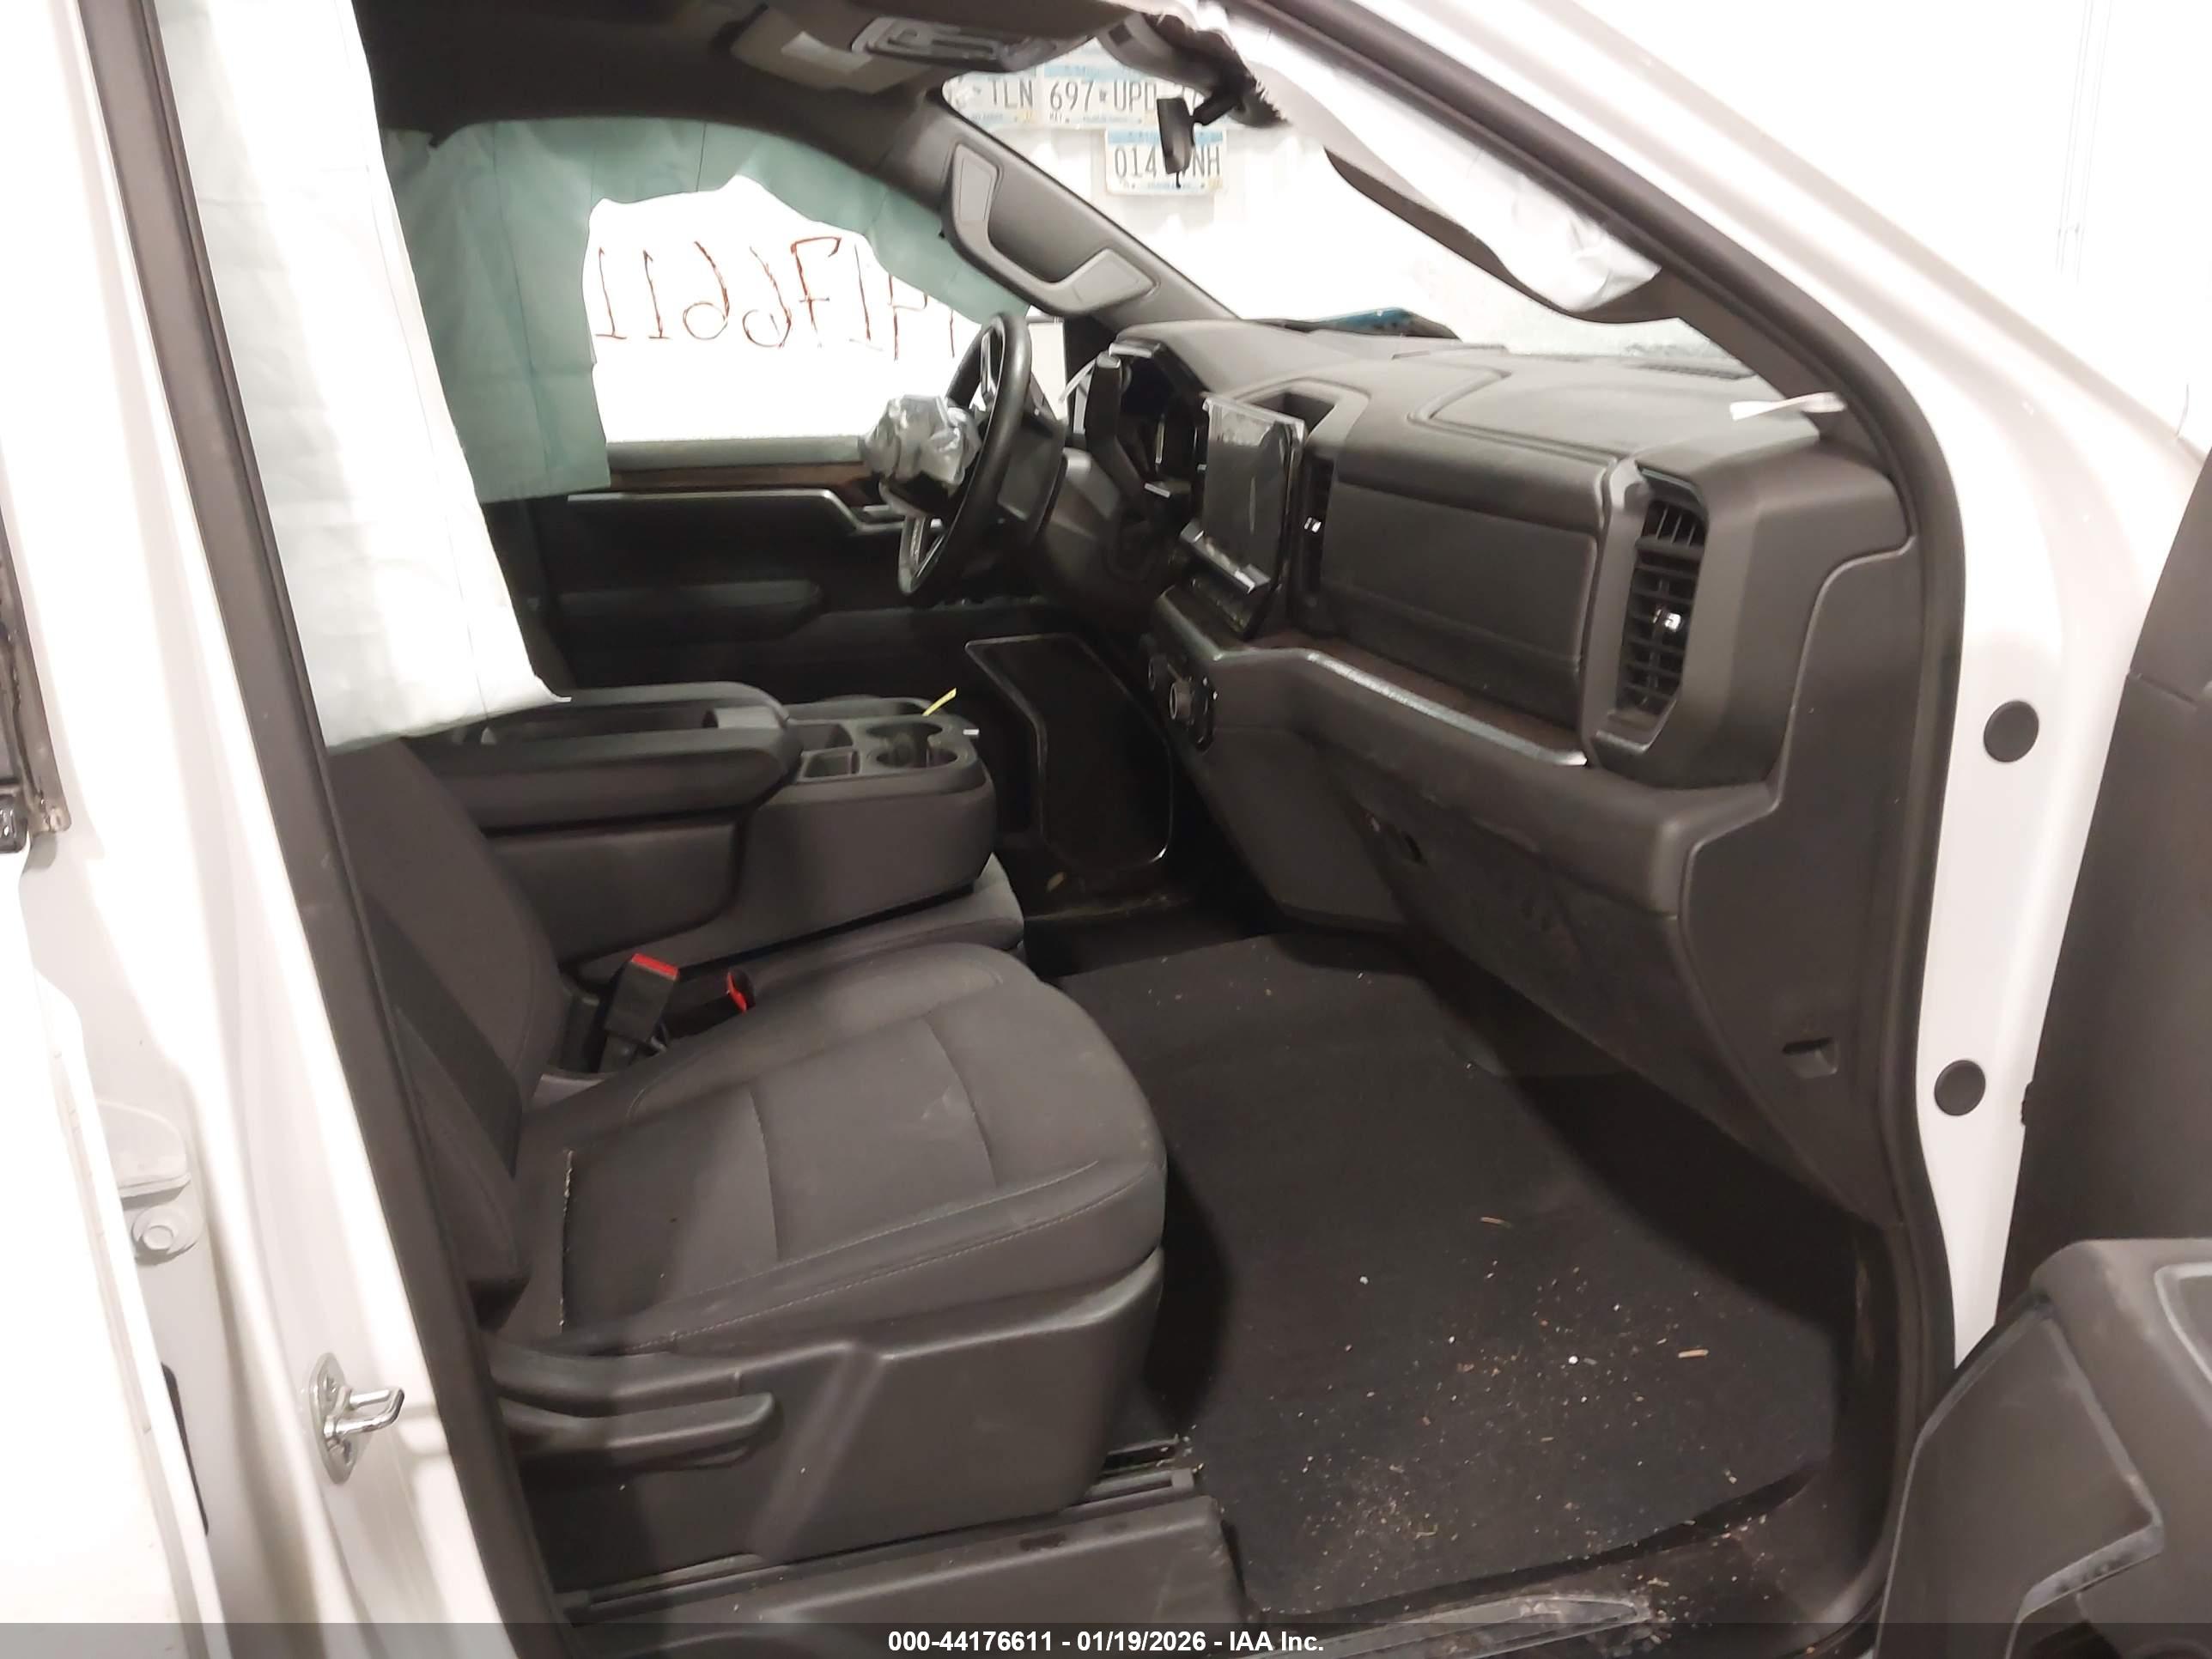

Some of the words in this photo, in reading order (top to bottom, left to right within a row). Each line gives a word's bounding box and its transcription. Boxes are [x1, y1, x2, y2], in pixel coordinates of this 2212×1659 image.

[1049, 79, 1095, 112] 697
[1115, 144, 1157, 178] 014
[1182, 144, 1220, 177] NH
